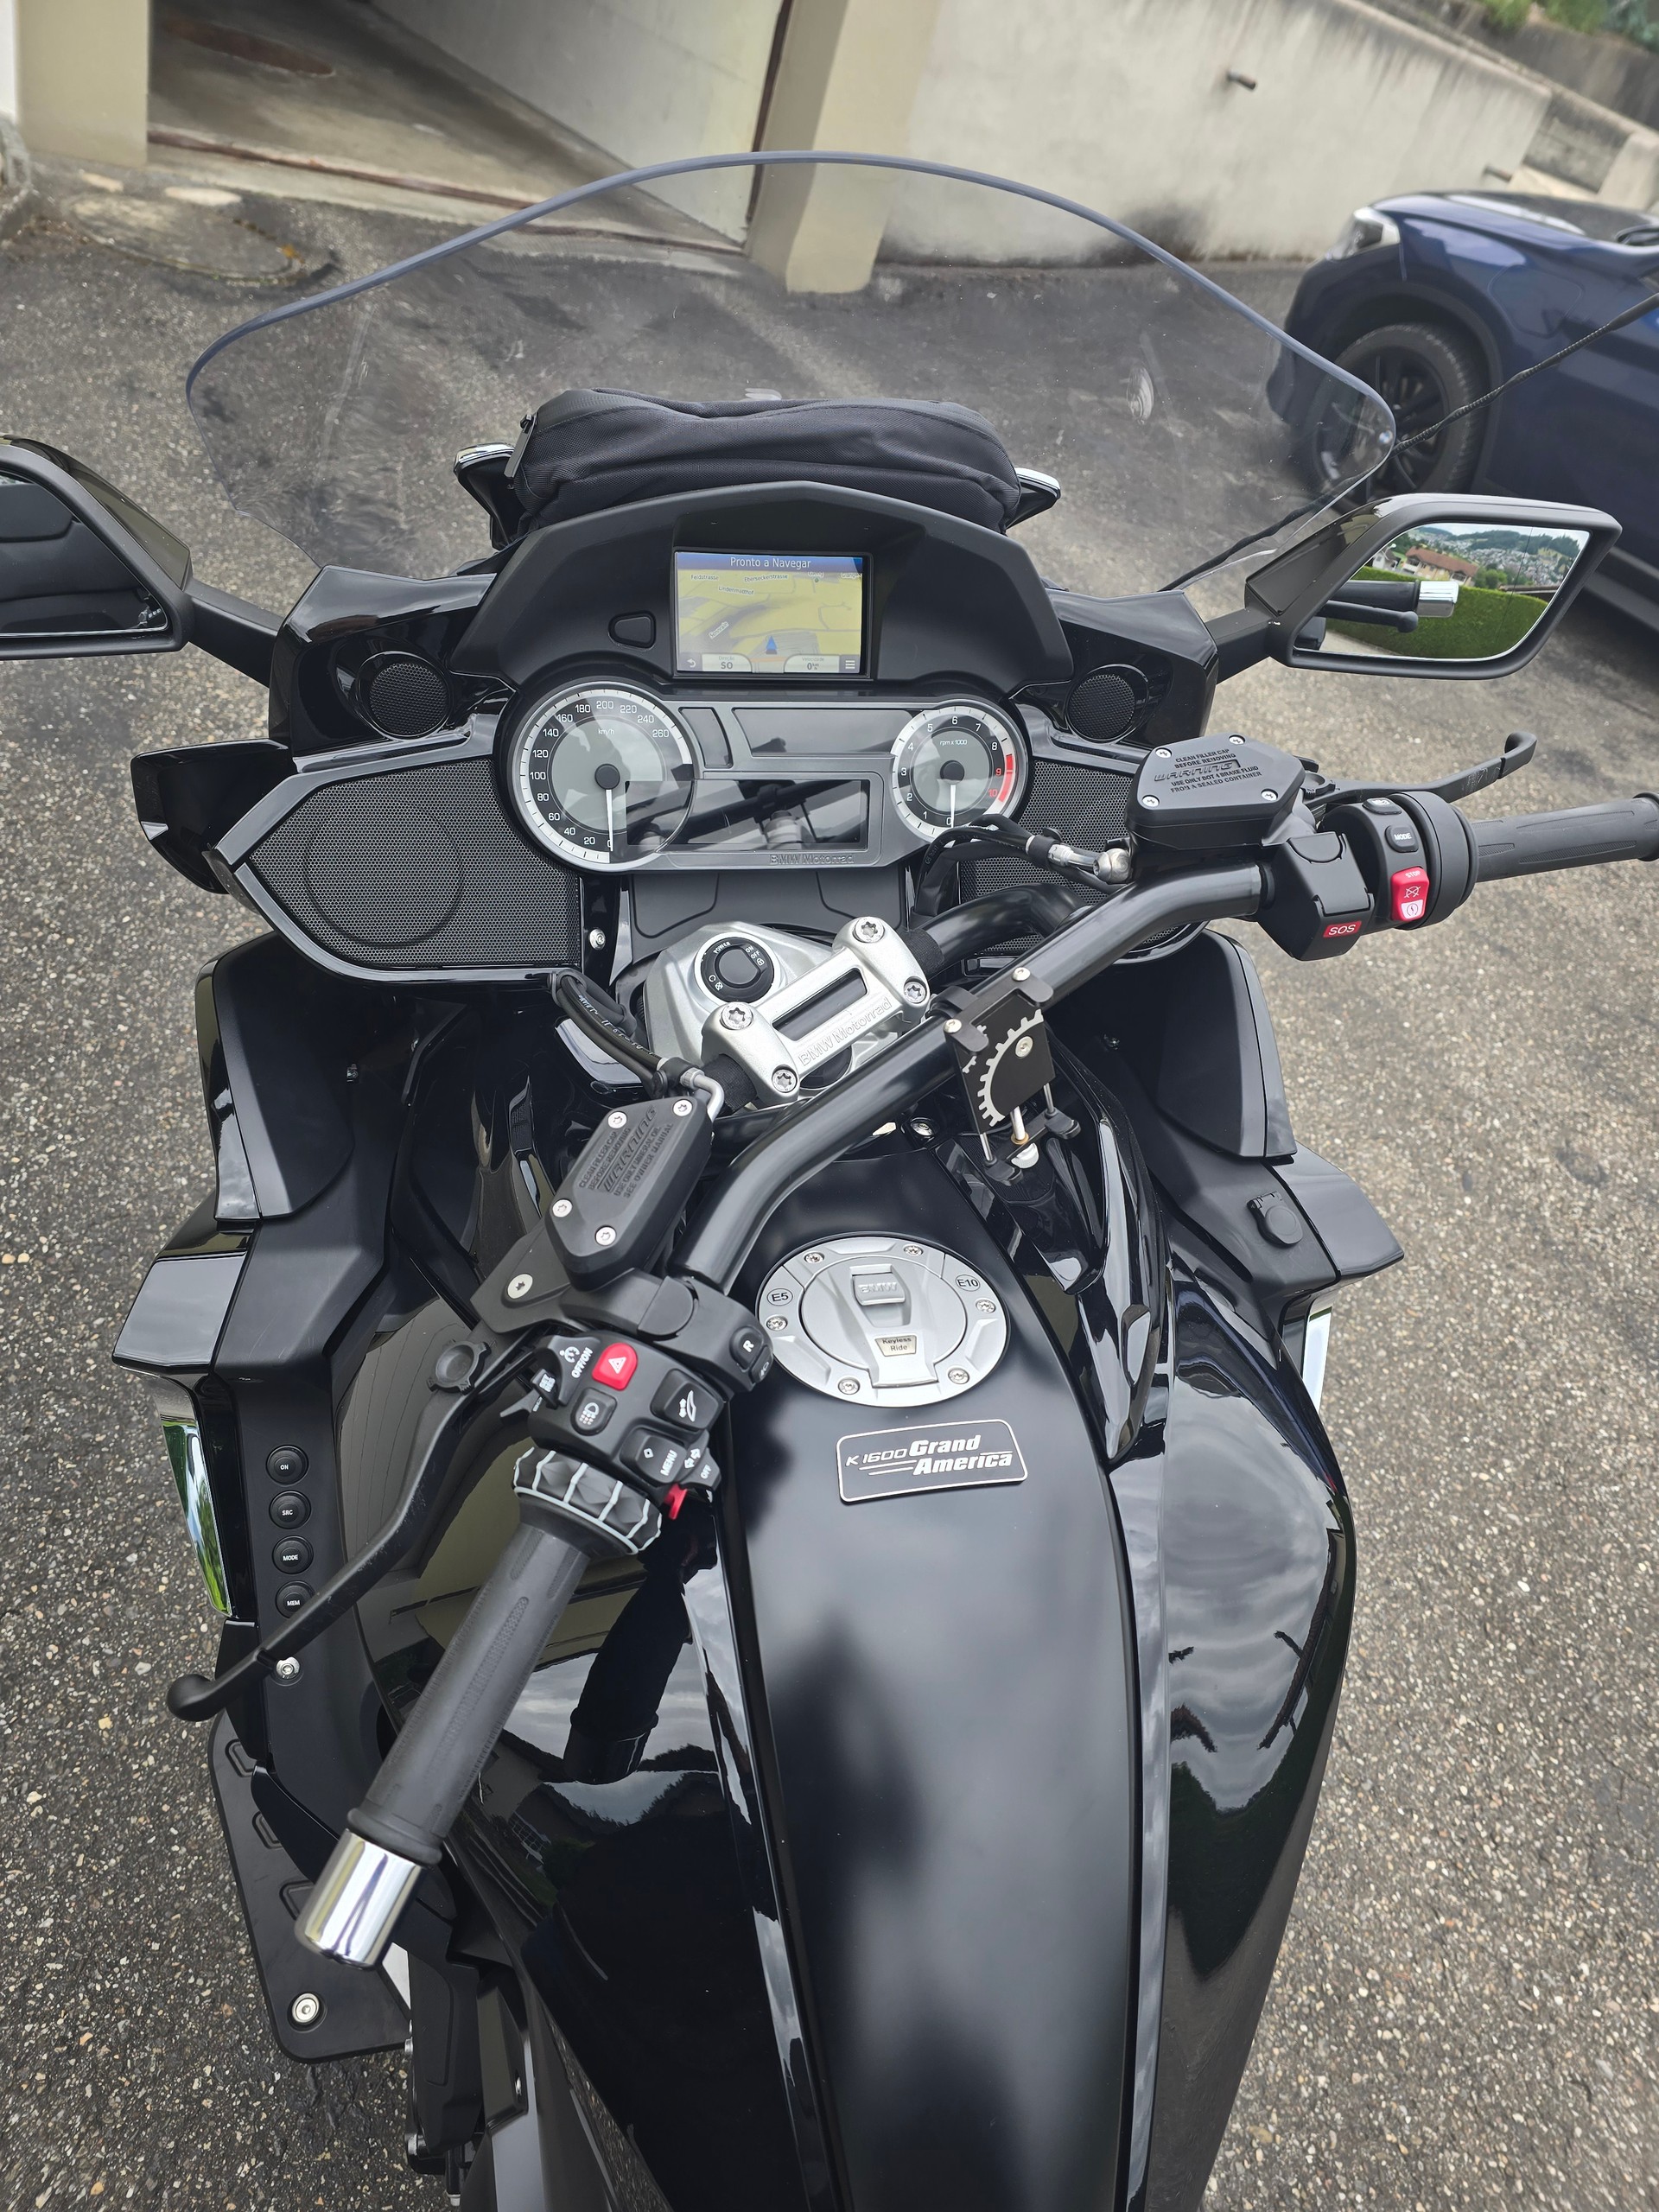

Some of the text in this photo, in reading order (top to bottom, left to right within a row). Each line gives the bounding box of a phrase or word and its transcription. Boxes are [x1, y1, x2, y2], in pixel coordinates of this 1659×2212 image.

[730, 557, 761, 567] Pronto
[773, 558, 811, 569] Navegar
[745, 574, 788, 582] Eberseckerstrasse
[1175, 753, 1236, 769] BEFORE REMOVING
[1176, 753, 1196, 763] CLEAN
[1197, 750, 1217, 759] FILLER
[1241, 765, 1258, 774] FLUID
[1198, 778, 1223, 787] SEALED
[1225, 771, 1262, 783] CONTAINER
[770, 855, 854, 863] BMW Motorrad
[1328, 924, 1356, 935] SOS
[713, 941, 731, 954] POWER
[751, 950, 760, 959] OFF
[798, 996, 892, 1067] BMW Motorrad
[858, 1282, 897, 1292] BMW
[957, 1278, 979, 1288] E10
[771, 1292, 789, 1302] E5
[743, 1339, 754, 1353] R
[845, 1435, 981, 1466] K 1600 Grand
[661, 1450, 677, 1476] MENU
[912, 1452, 1013, 1476] America
[700, 1464, 712, 1479] OFF
